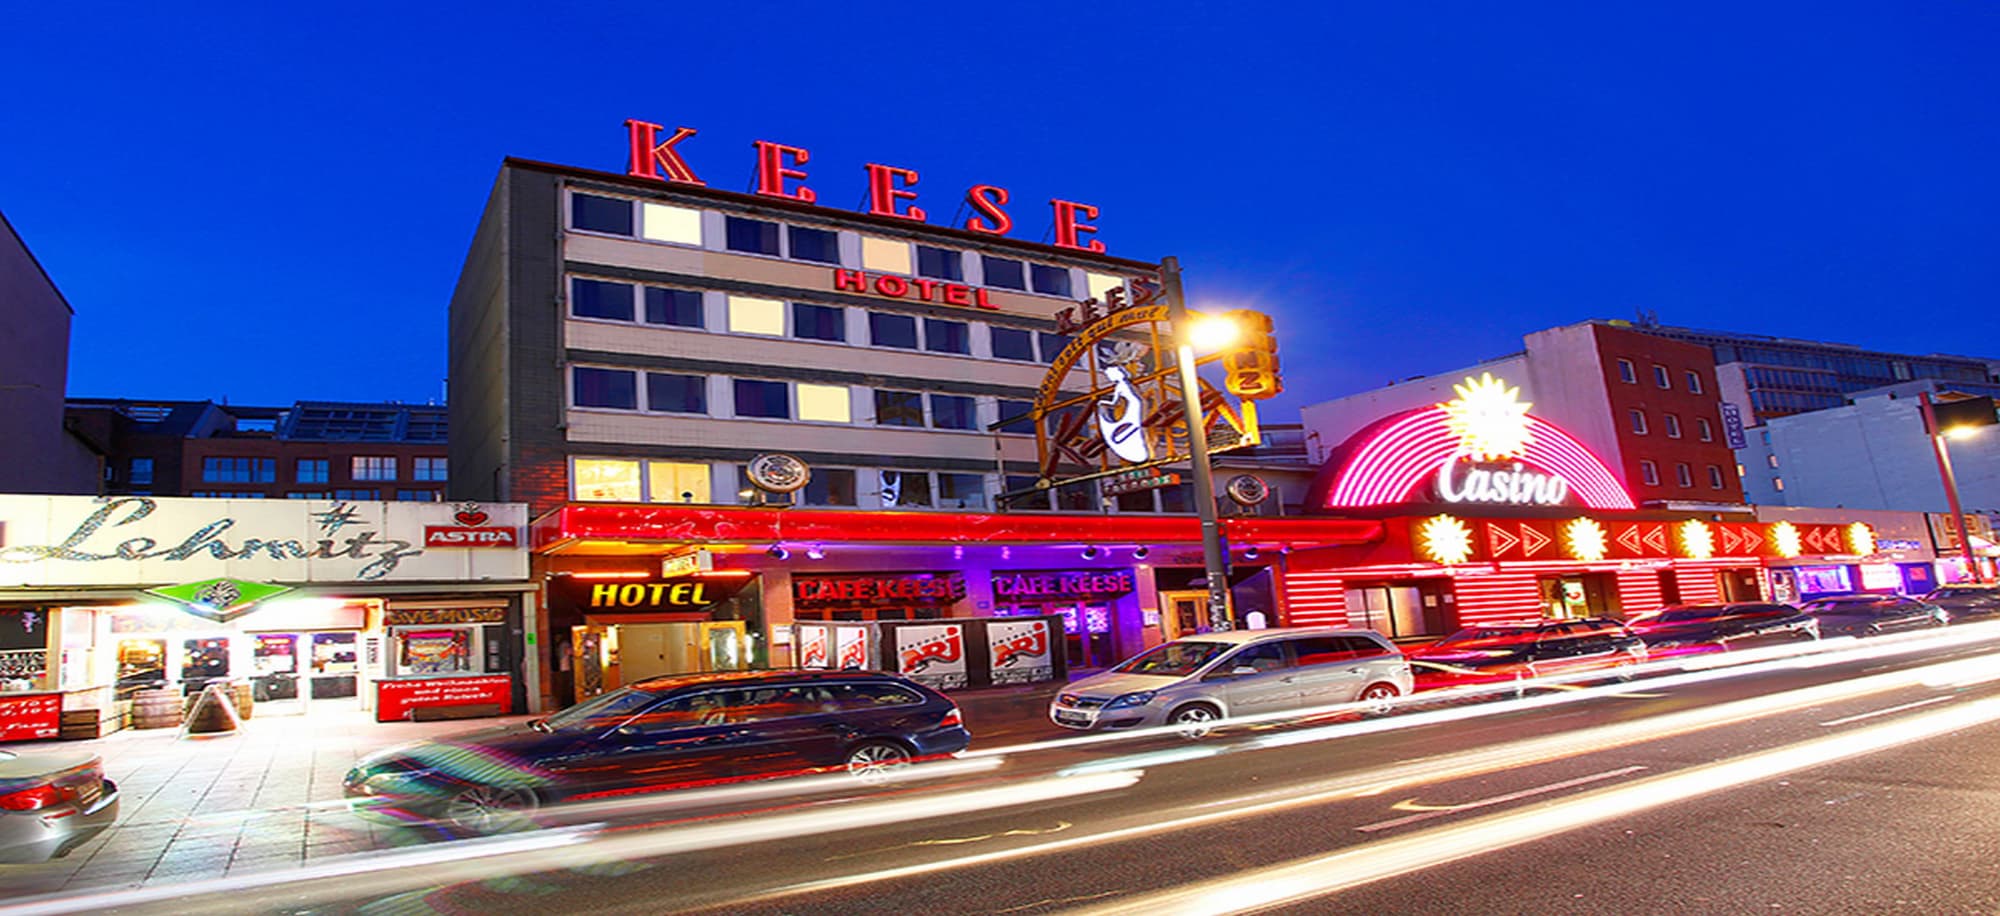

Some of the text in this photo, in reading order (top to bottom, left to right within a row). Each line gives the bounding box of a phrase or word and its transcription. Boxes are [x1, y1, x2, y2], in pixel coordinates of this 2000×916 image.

[623, 118, 1106, 254] KEESE
[834, 269, 1000, 311] HOTEL
[1438, 447, 1567, 505] Casino
[0, 497, 422, 580] Lehmitz
[429, 531, 513, 542] ASTRA
[591, 582, 711, 607] HOTEL
[1060, 575, 1132, 593] KEESE
